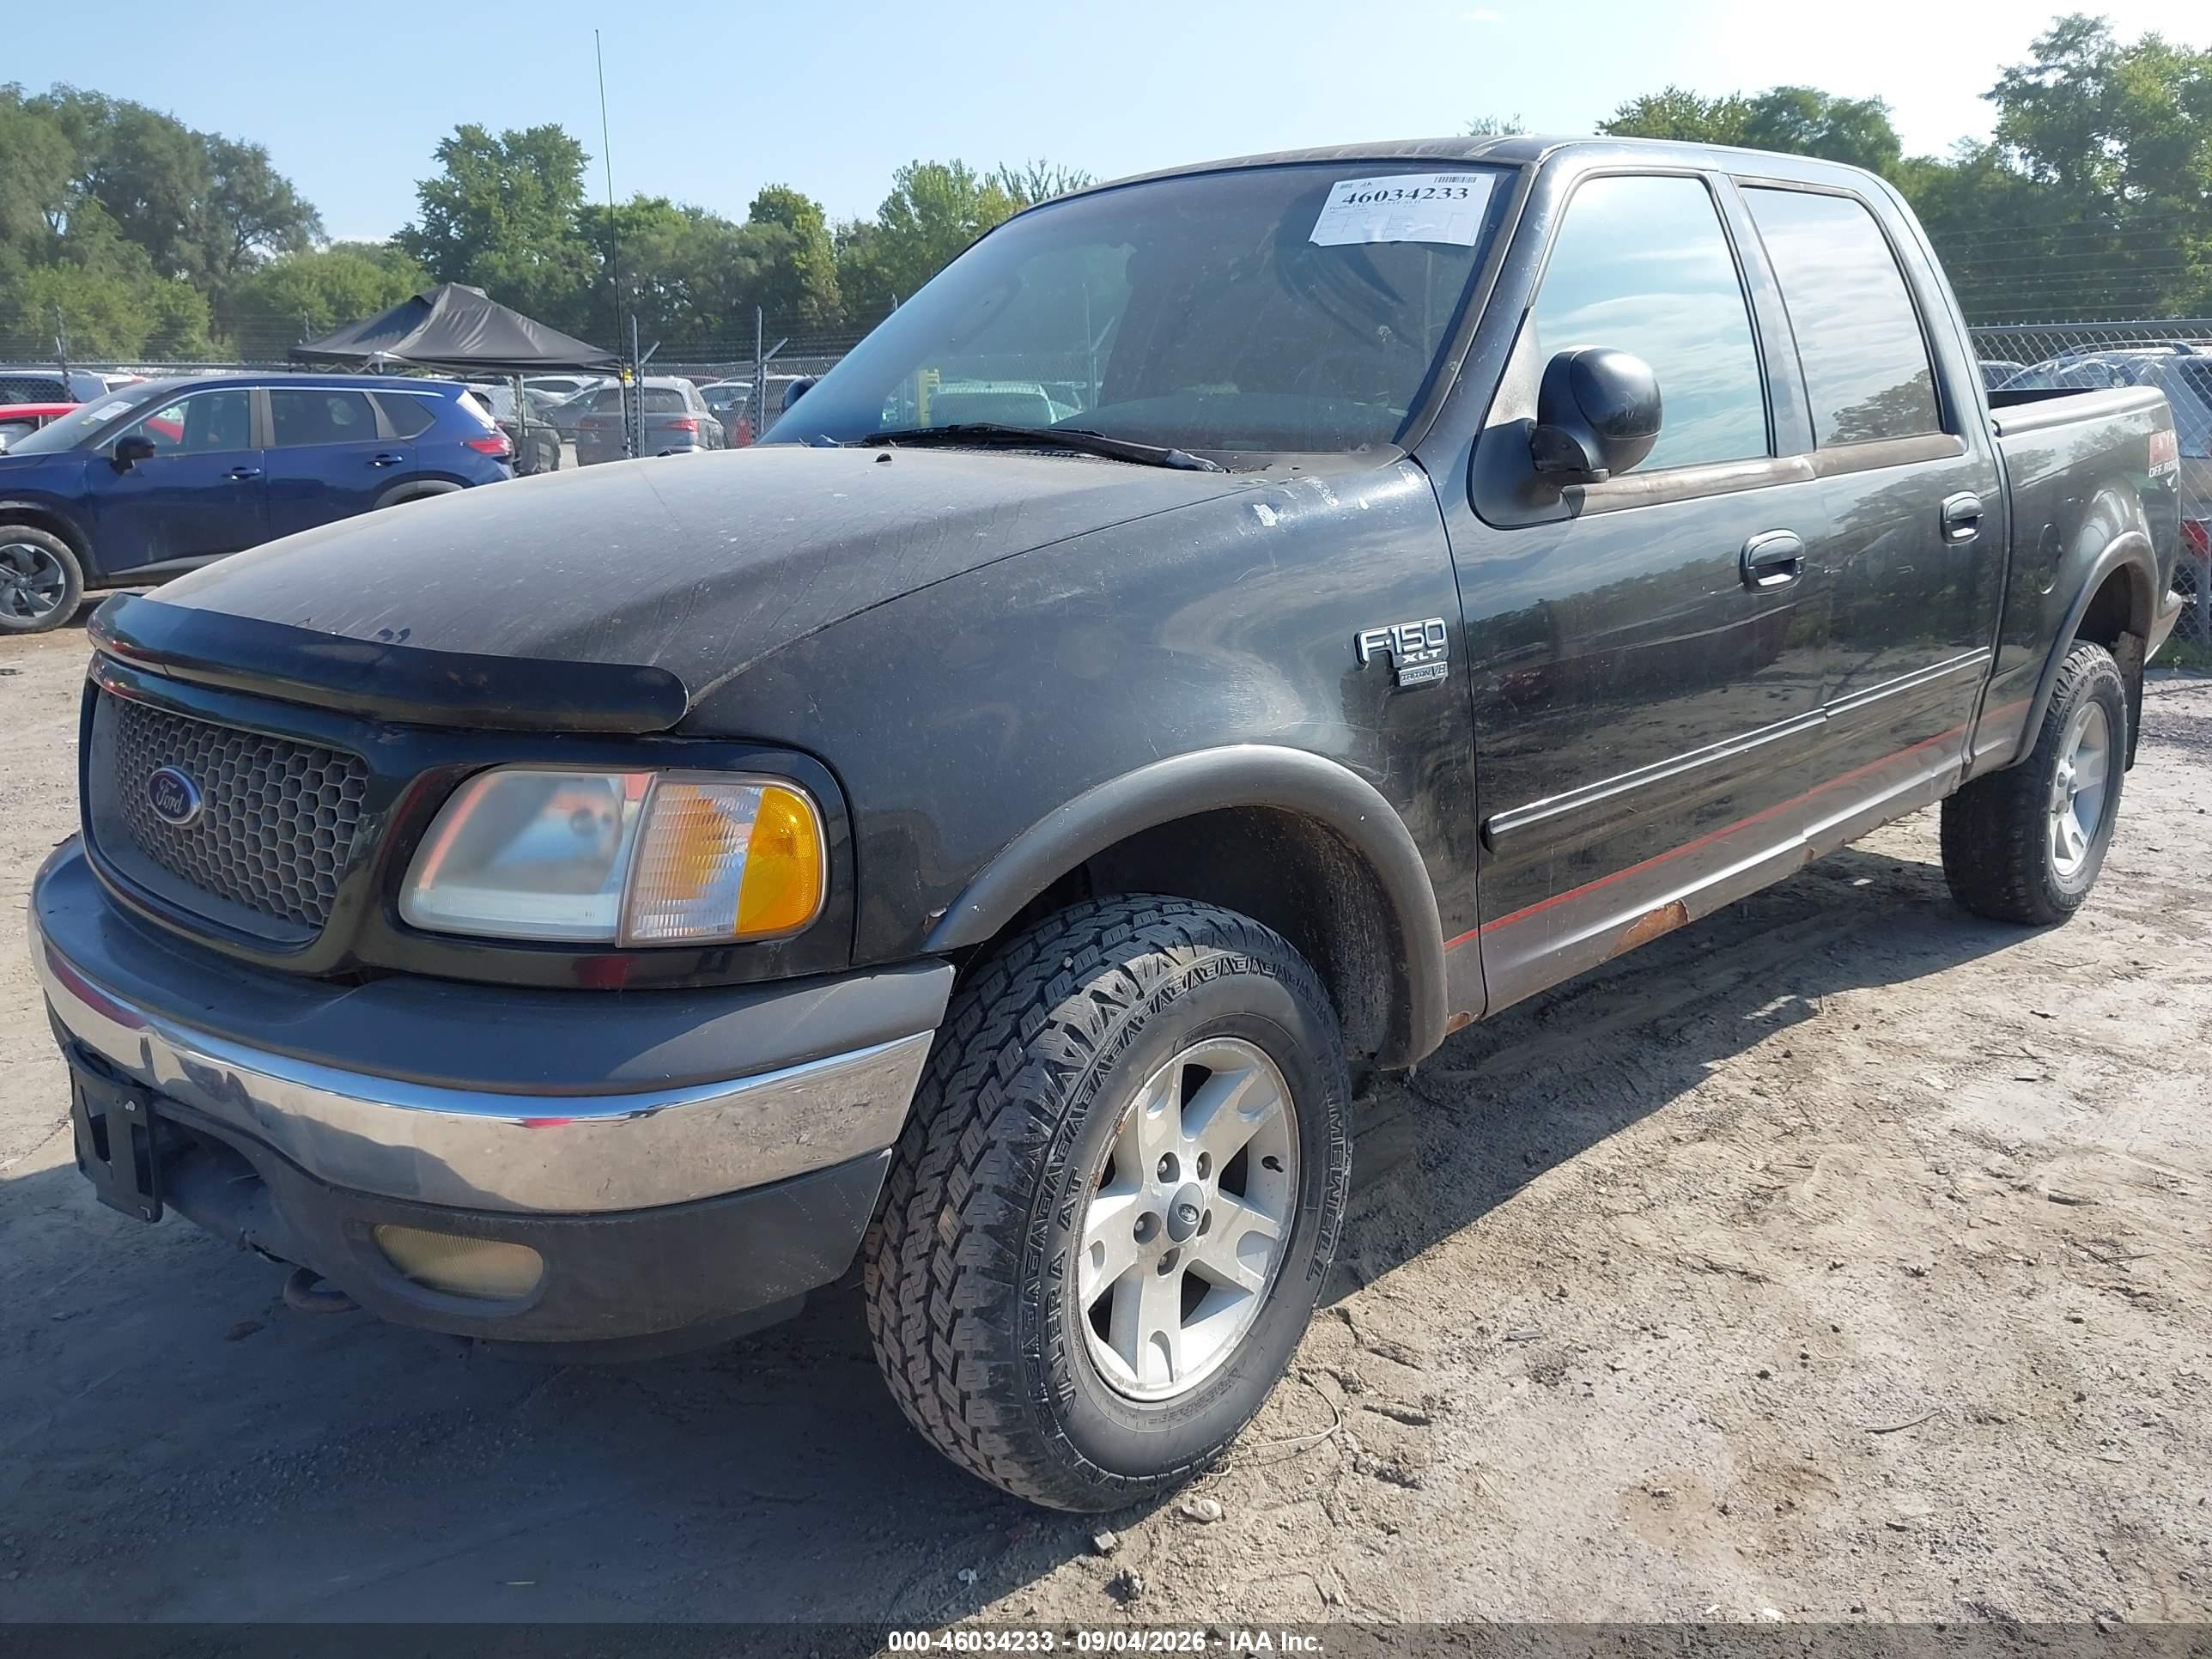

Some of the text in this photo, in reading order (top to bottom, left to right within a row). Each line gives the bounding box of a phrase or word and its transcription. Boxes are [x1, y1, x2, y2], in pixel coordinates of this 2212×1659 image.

[1341, 187, 1470, 205] 46034233
[1402, 648, 1442, 664] XLT
[1401, 664, 1446, 682] TRITON V8
[155, 777, 185, 815] Ford
[1057, 1166, 1085, 1231] AT
[1046, 1247, 1078, 1417] VALERA
